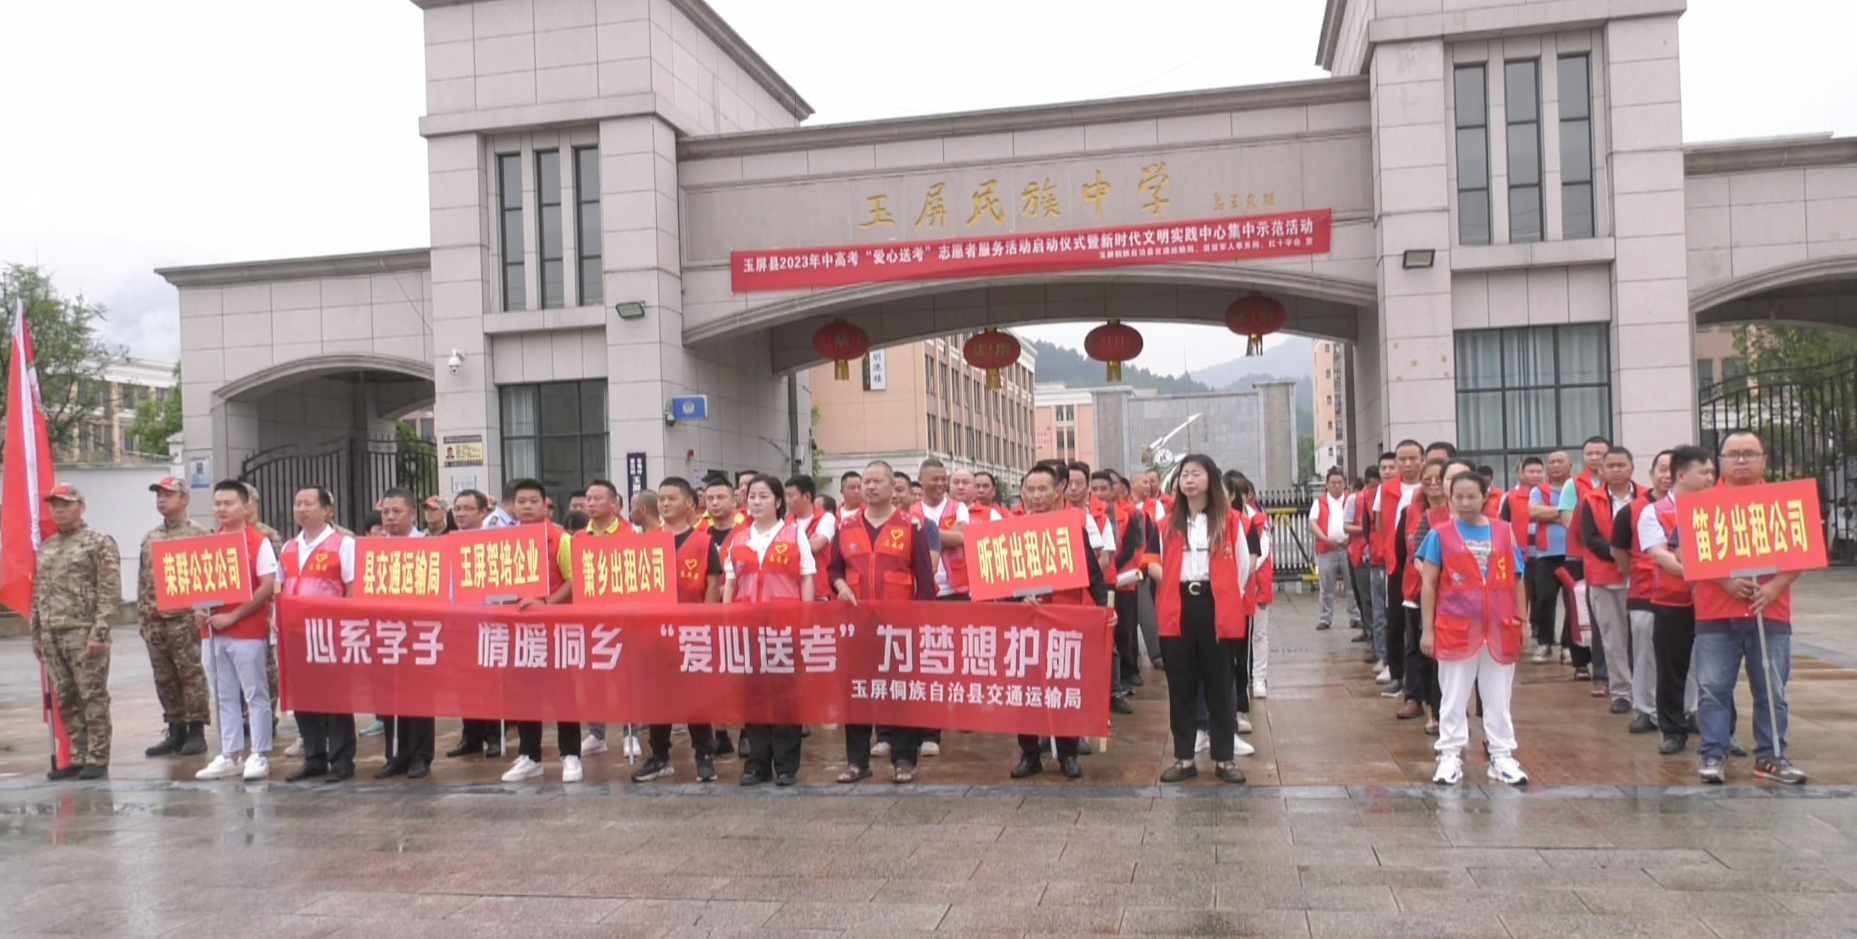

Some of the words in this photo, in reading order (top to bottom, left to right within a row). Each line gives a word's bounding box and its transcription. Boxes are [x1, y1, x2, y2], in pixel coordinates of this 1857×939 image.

[859, 162, 1171, 231] 玉屏民族中学
[976, 526, 1074, 584] 昕昕出租公司
[1692, 498, 1808, 562] 笛乡出租公司
[162, 547, 241, 597] 荣群公交公司
[363, 550, 441, 596] 县交通运输局
[460, 538, 540, 588] 玉屏驾培企业
[581, 547, 666, 597] 箫乡出租公司
[304, 618, 444, 665] 心系学子
[477, 621, 623, 670] 情暖侗乡
[876, 624, 1083, 680] 为梦想护航
[851, 679, 1083, 710] 玉屏侗族自治县交通运输局
